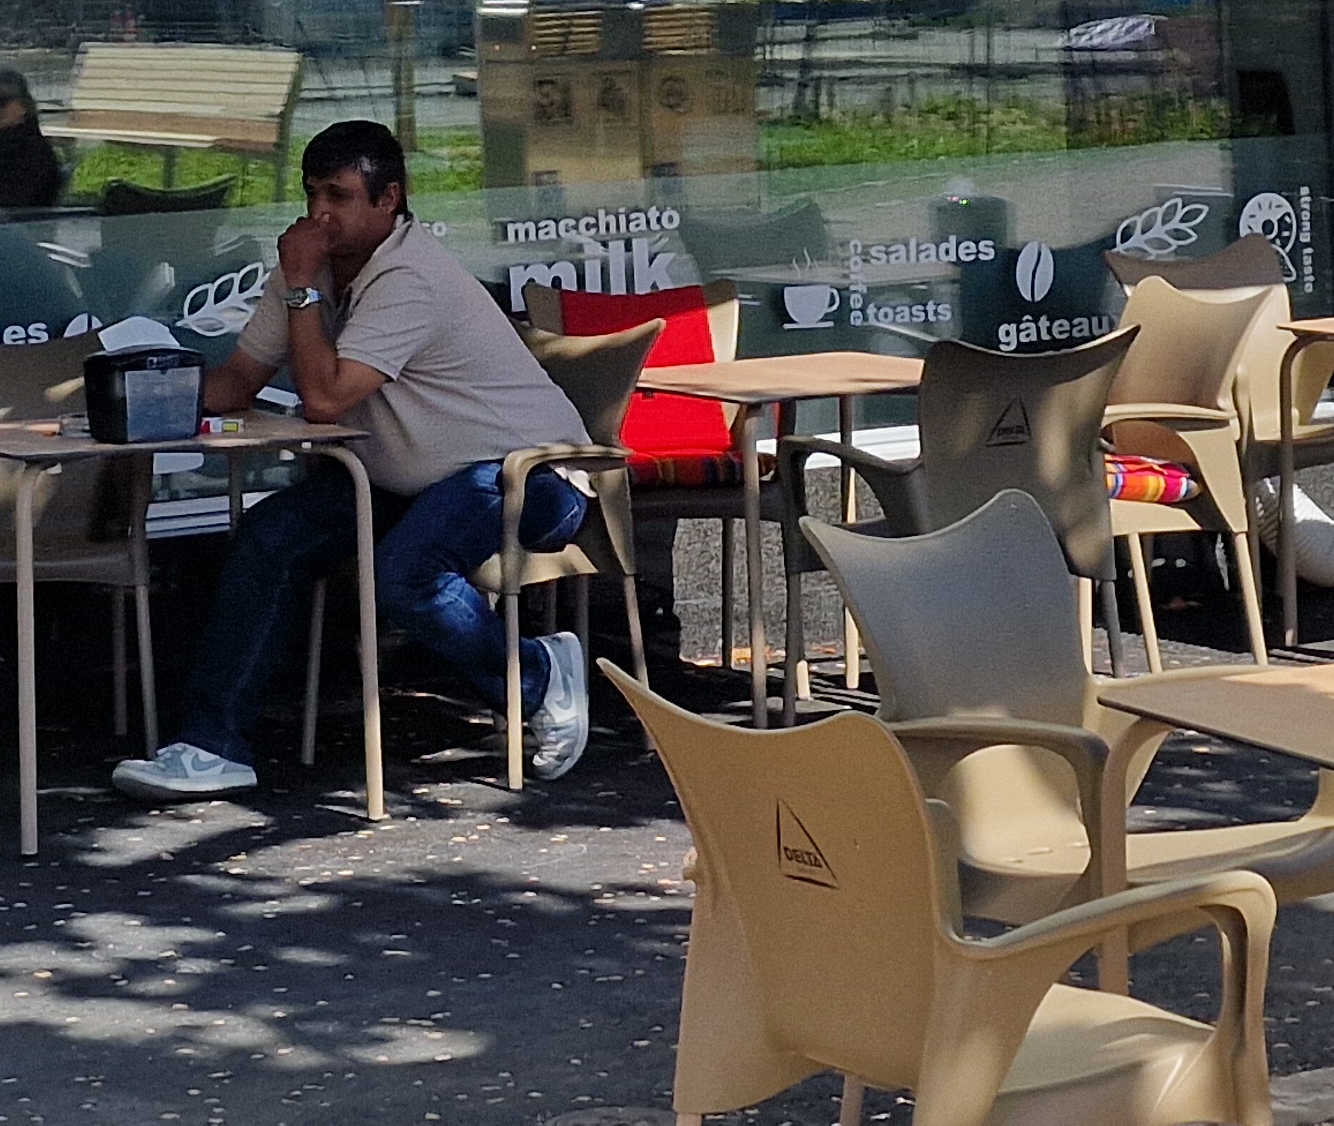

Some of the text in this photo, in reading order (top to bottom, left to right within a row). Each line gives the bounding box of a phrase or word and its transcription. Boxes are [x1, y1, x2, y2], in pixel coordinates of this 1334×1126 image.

[507, 205, 680, 244] macchiato
[1299, 186, 1312, 243] strong
[869, 235, 996, 266] salades
[509, 238, 677, 312] milk
[849, 238, 868, 327] coffee
[866, 300, 953, 324] toasts
[783, 846, 823, 868] DELTA
